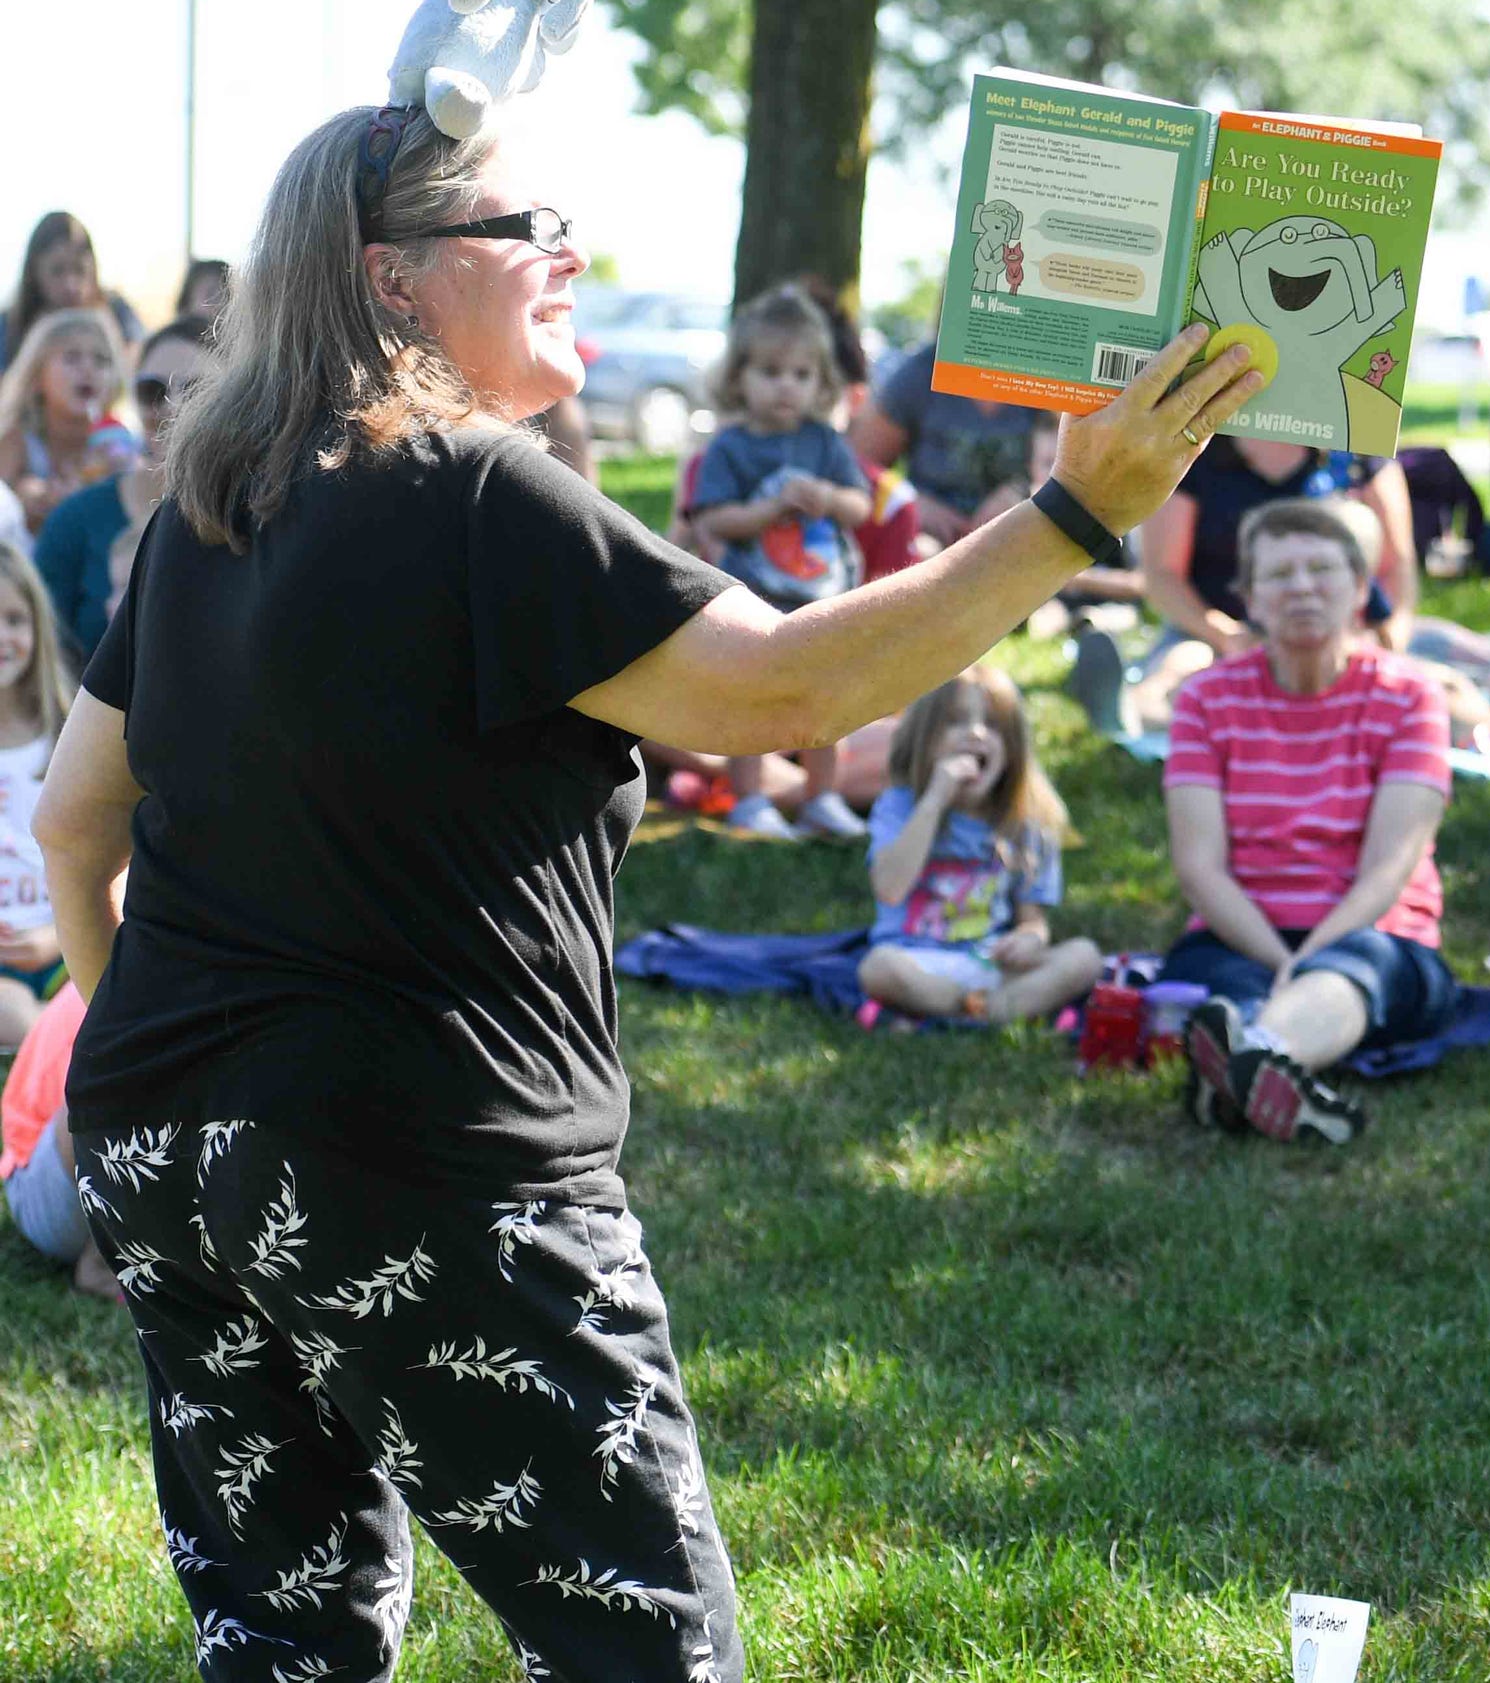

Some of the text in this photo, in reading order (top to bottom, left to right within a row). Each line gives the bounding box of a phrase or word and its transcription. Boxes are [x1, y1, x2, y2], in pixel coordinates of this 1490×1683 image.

[986, 91, 1195, 139] Meet Elephant Gerald and Piggie
[1204, 123, 1218, 167] Willems
[1262, 122, 1323, 141] ELEPHANT
[1323, 132, 1331, 141] &
[1333, 132, 1372, 147] PIGGIE
[1221, 147, 1410, 194] Are You Ready
[1212, 173, 1235, 193] to
[1244, 177, 1297, 206] Play
[1306, 185, 1412, 218] Outside?
[970, 294, 985, 309] Mo
[1255, 411, 1334, 439] Willems
[1316, 1611, 1348, 1635] Elephant
